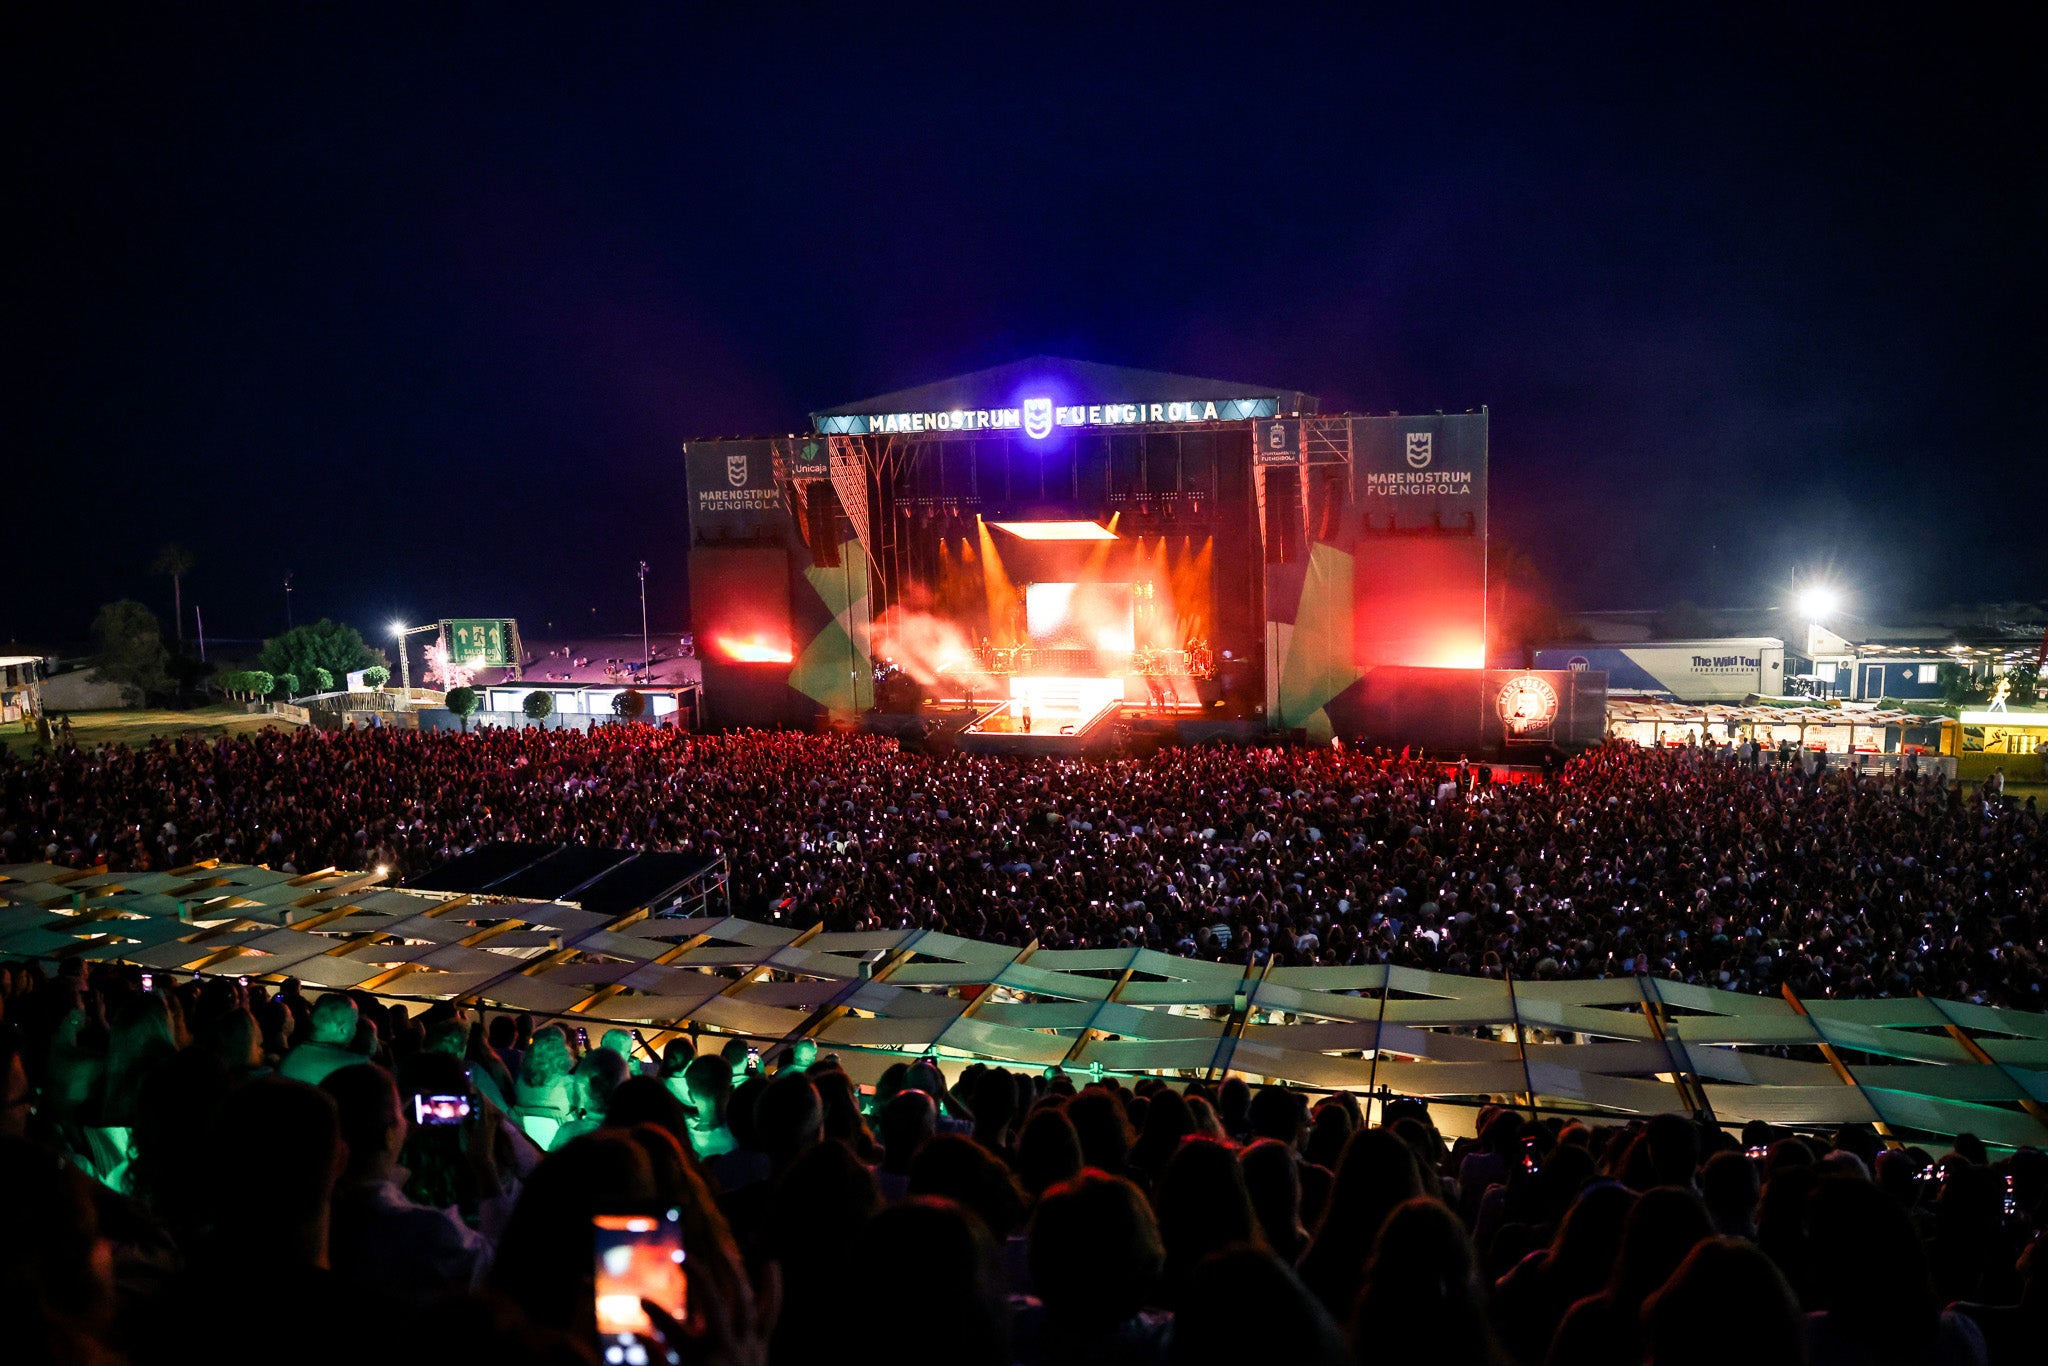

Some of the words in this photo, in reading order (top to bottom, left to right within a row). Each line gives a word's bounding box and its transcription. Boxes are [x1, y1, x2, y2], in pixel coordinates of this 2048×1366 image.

[869, 408, 1020, 433] MARENOSTRUM
[1056, 401, 1218, 425] FUENGIROLA
[795, 464, 827, 474] Unicaja
[1367, 471, 1471, 484] MARENOSTRUM
[700, 489, 780, 501] MARENOSTRUM
[1367, 484, 1471, 496] FUENGIROLA
[700, 500, 780, 511] FUENGIROLA
[1569, 663, 1588, 672] TWT
[1692, 656, 1711, 667] The
[1713, 656, 1738, 667] Wild
[1500, 679, 1556, 706] MARENOSTRUM
